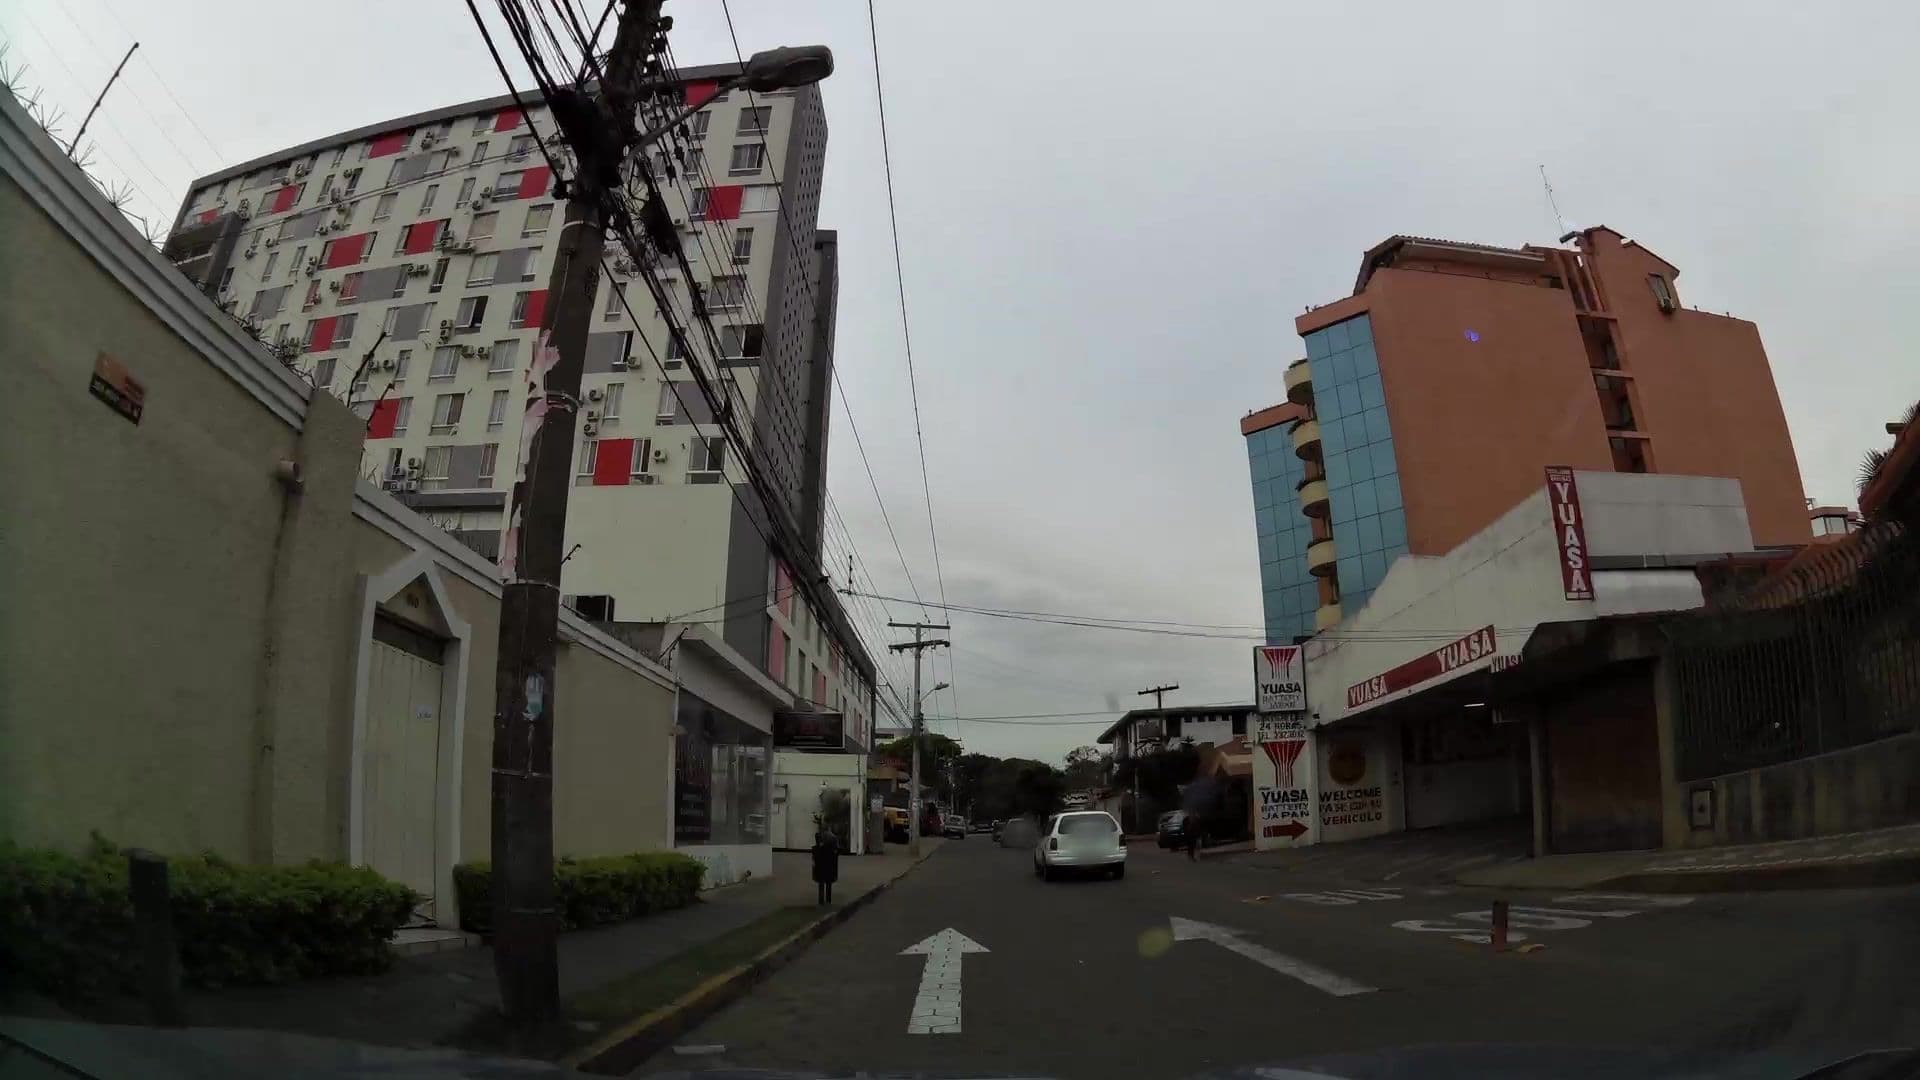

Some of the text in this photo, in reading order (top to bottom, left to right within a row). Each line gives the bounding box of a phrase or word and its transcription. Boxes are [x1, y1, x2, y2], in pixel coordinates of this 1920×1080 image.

[1554, 482, 1586, 592] YUASA
[1436, 630, 1493, 673] YUASA
[1261, 681, 1302, 694] YUASA
[1349, 675, 1388, 706] YUASA
[1261, 789, 1309, 804] YUASA
[1319, 787, 1381, 802] WELCOME
[1261, 803, 1309, 813] BATTERY
[1262, 810, 1310, 821] JAPAN
[1322, 812, 1382, 826] VEHICULO
